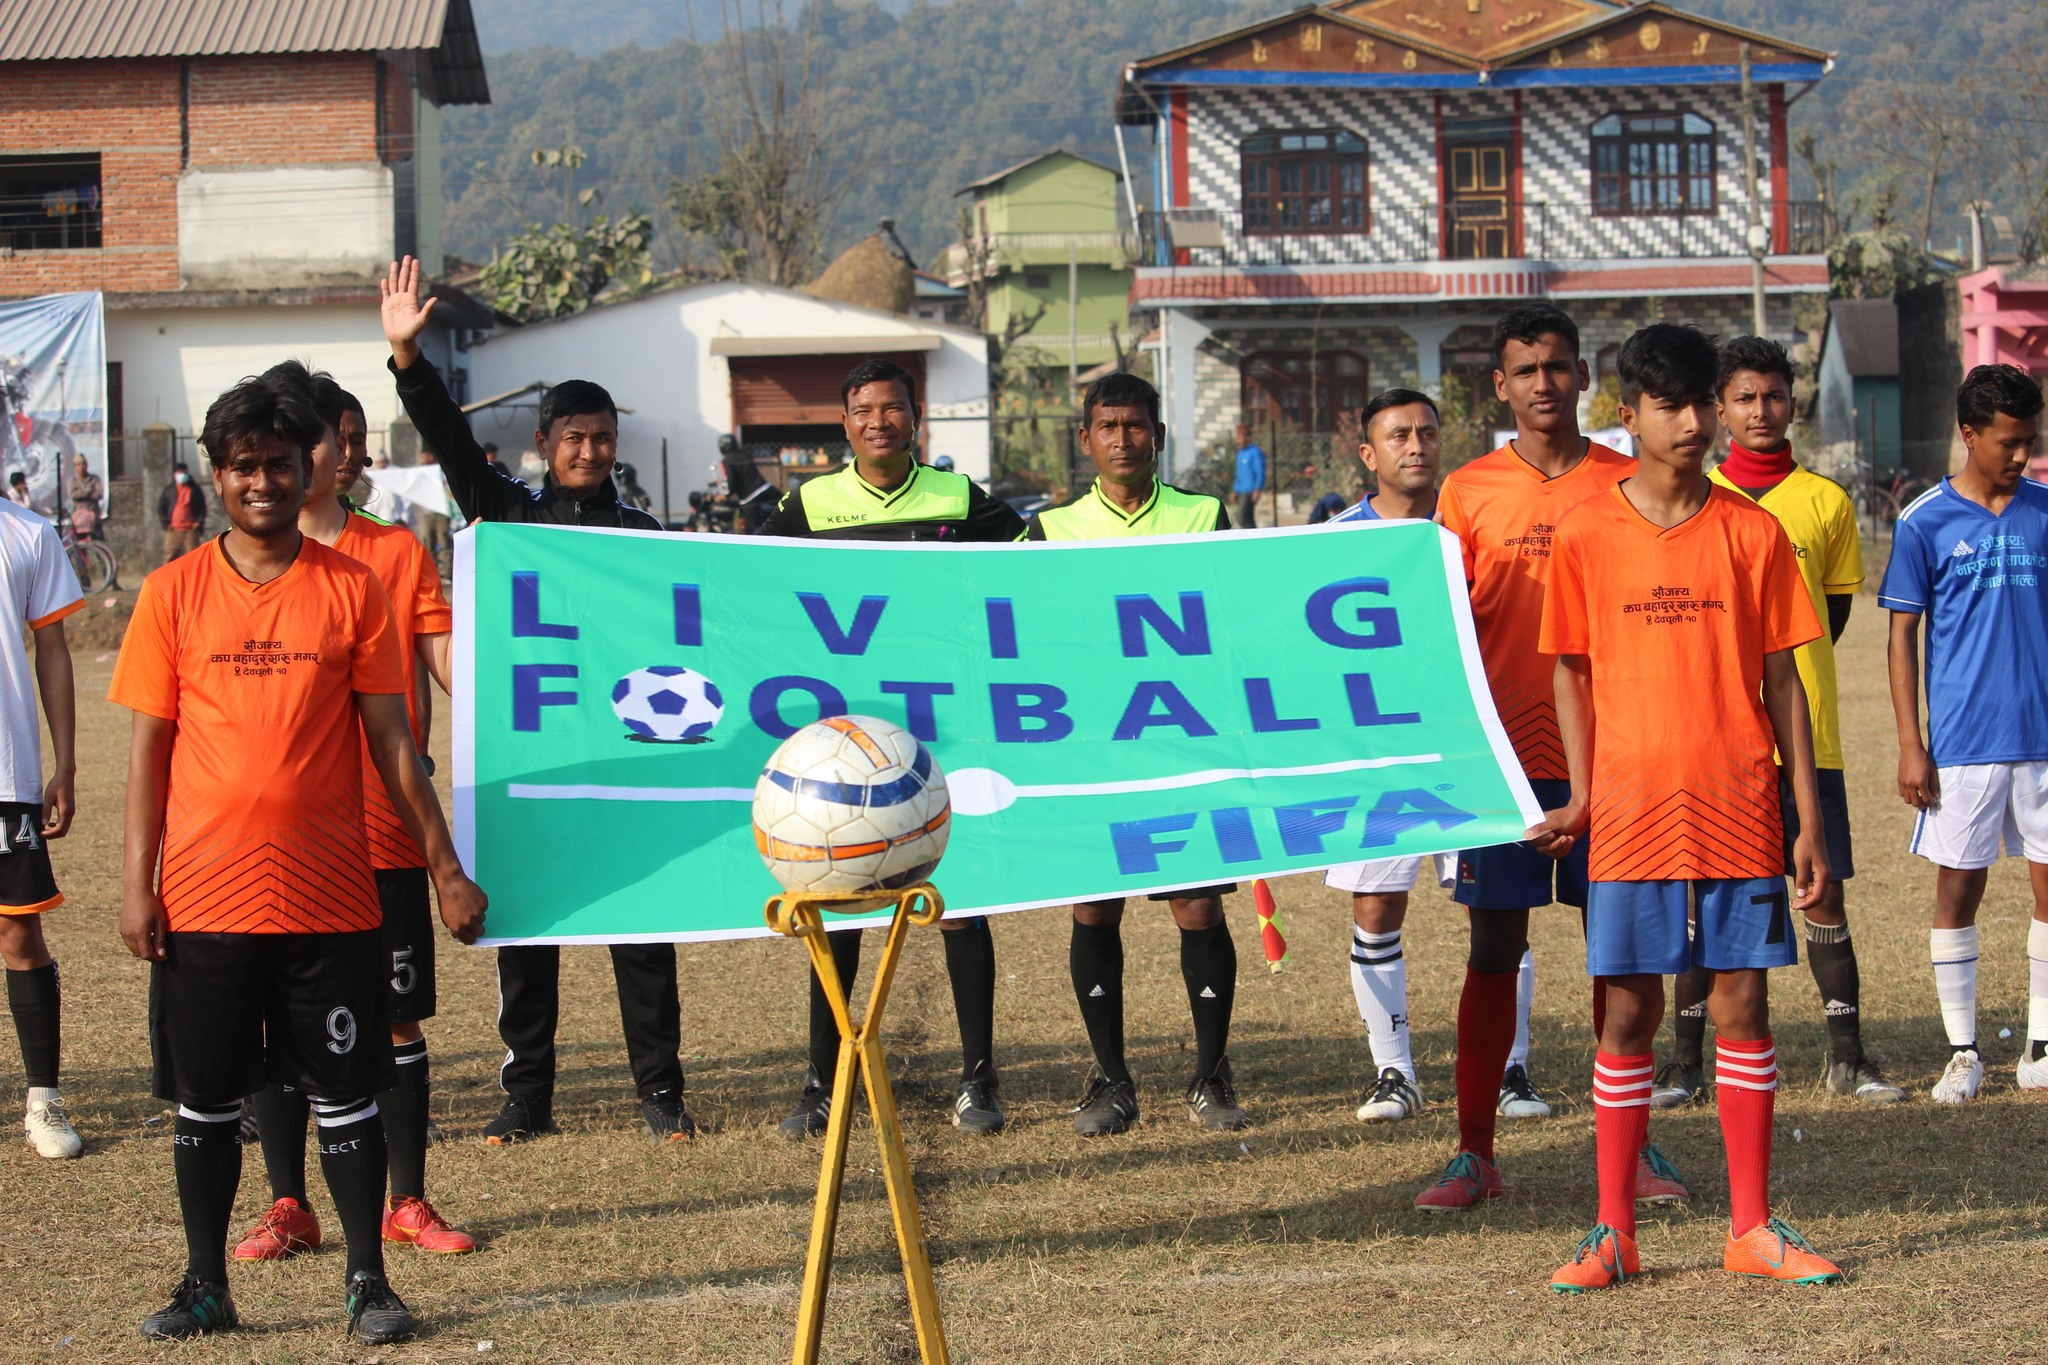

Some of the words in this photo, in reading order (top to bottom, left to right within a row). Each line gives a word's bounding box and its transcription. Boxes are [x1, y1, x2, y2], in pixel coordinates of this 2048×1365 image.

[826, 514, 868, 524] KELME
[1623, 603, 1641, 614] कप
[211, 654, 231, 663] कप
[390, 945, 418, 994] 5
[327, 1006, 357, 1055] 9
